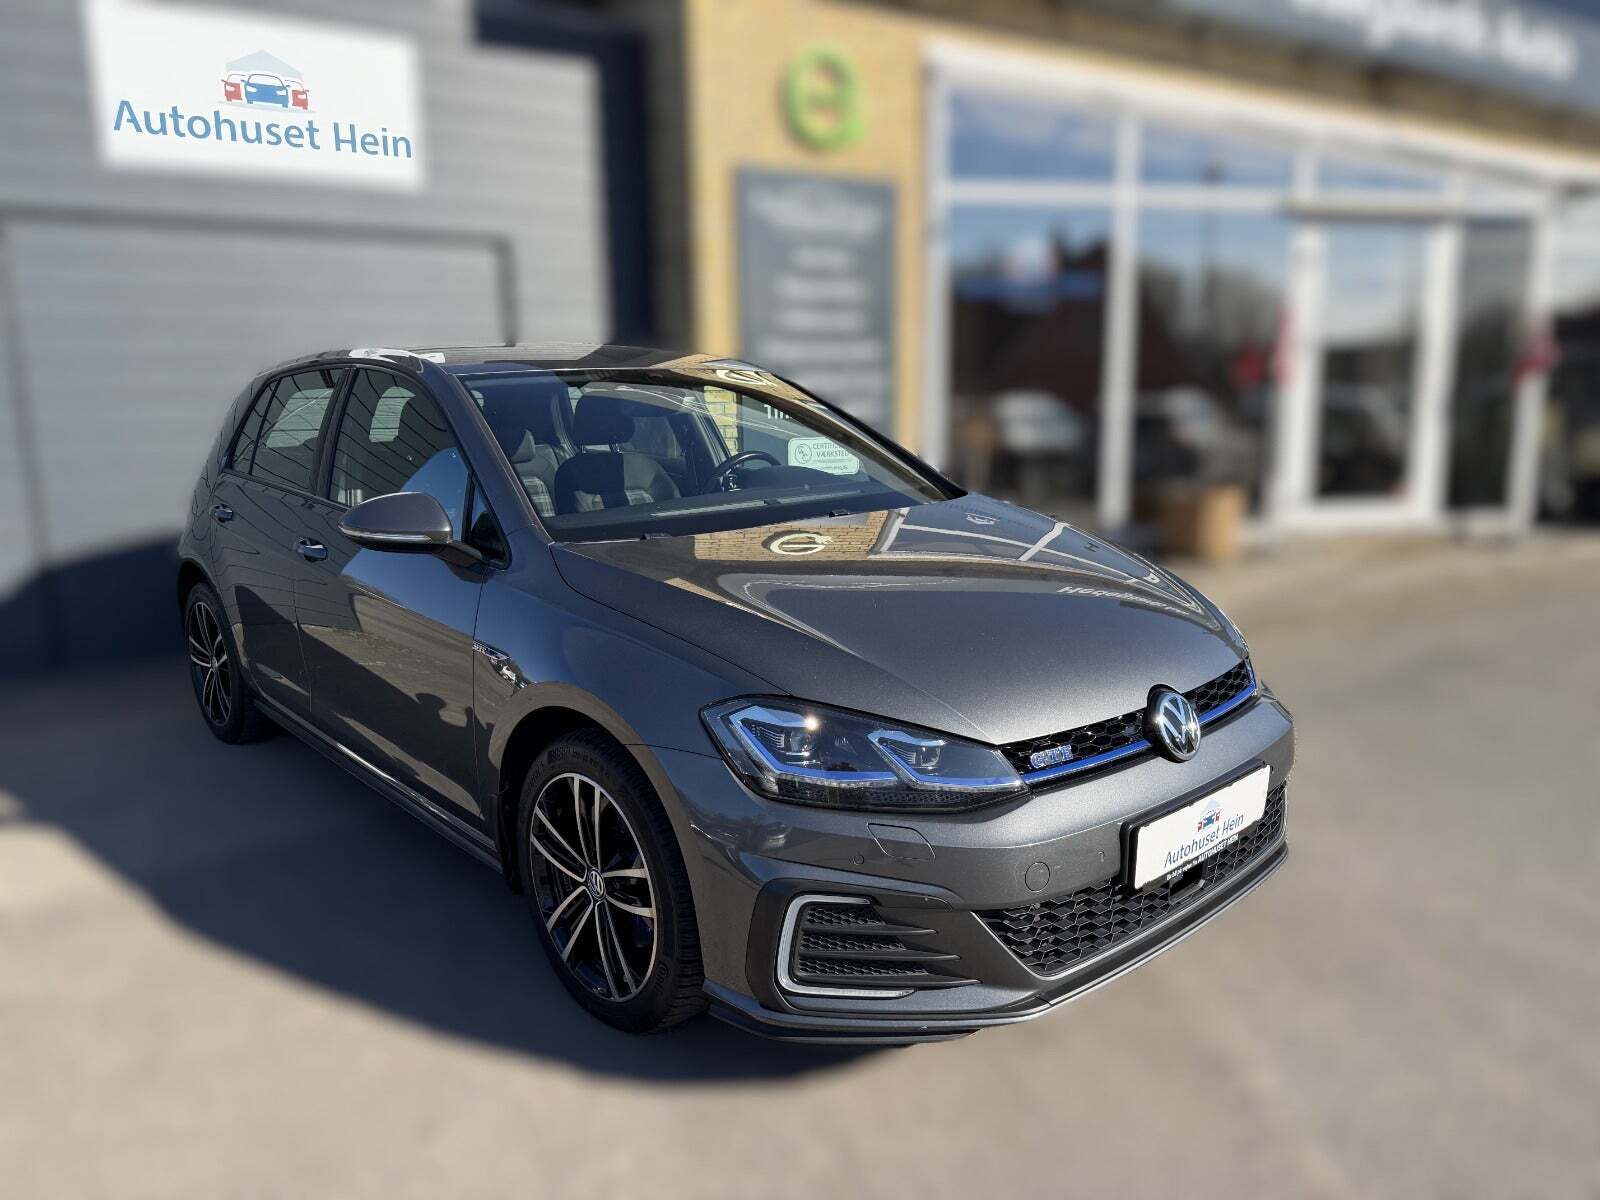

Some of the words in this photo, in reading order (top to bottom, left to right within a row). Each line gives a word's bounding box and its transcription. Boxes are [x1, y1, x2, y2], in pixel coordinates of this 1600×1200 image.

[113, 99, 320, 150] Autohuset
[333, 121, 413, 159] Hein
[1030, 744, 1073, 769] GTE
[1164, 825, 1220, 868] Autohuset
[1222, 814, 1244, 836] Hein
